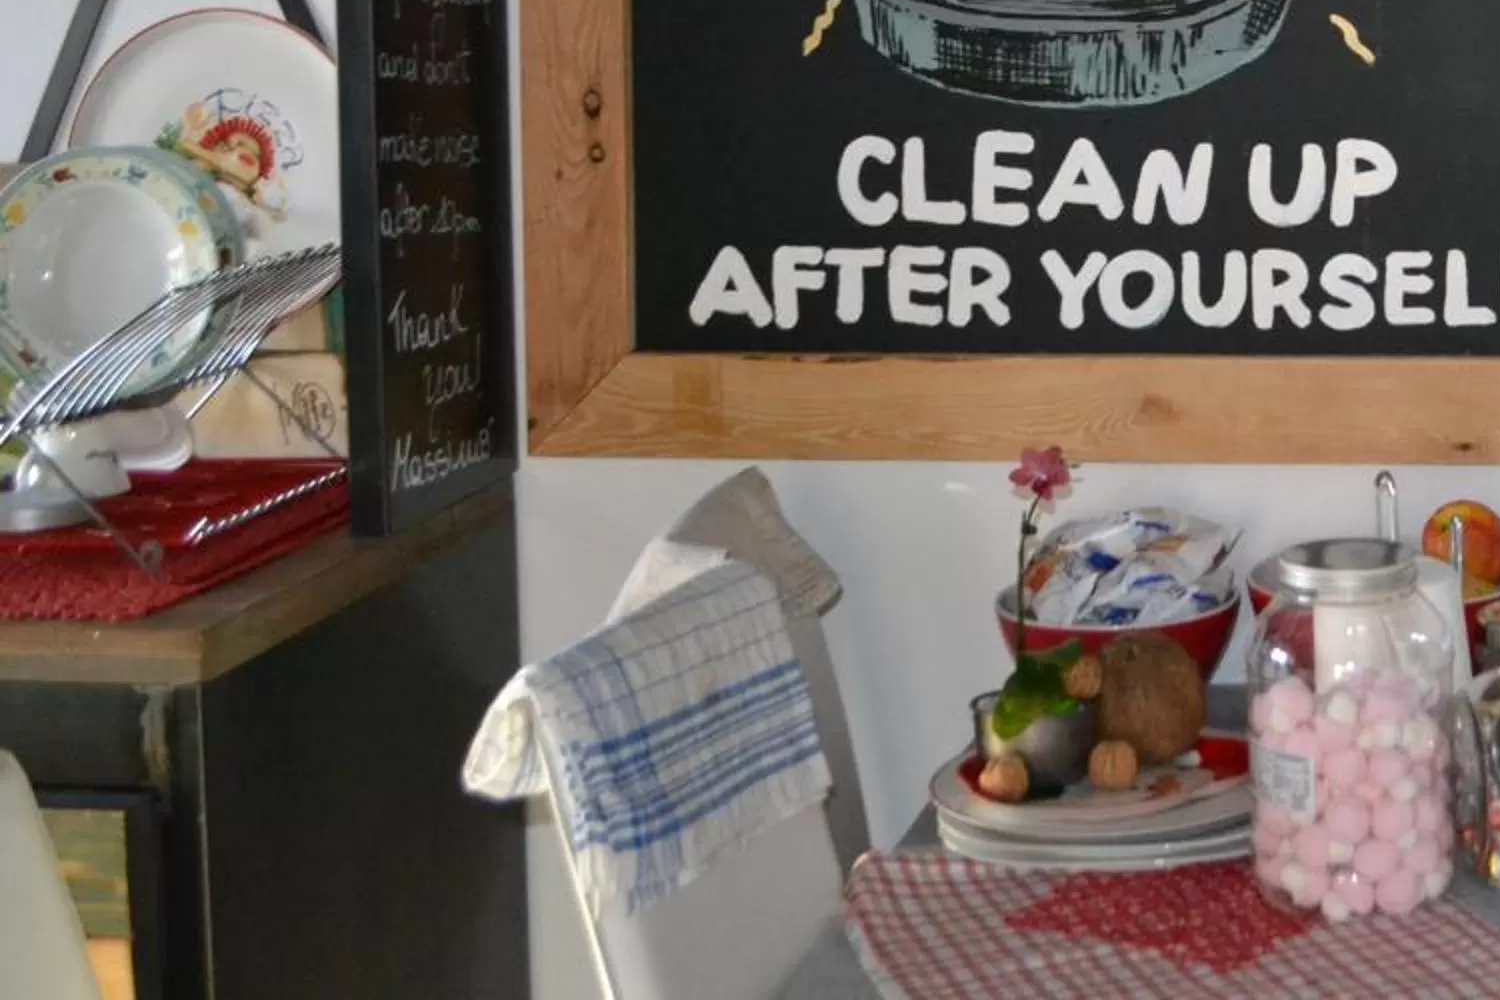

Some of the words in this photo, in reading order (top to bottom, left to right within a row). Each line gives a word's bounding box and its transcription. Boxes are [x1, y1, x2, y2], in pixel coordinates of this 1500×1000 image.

[378, 42, 418, 83] and
[836, 129, 1215, 228] CLEAN
[1246, 136, 1399, 229] UP
[688, 244, 1012, 330] AFTER
